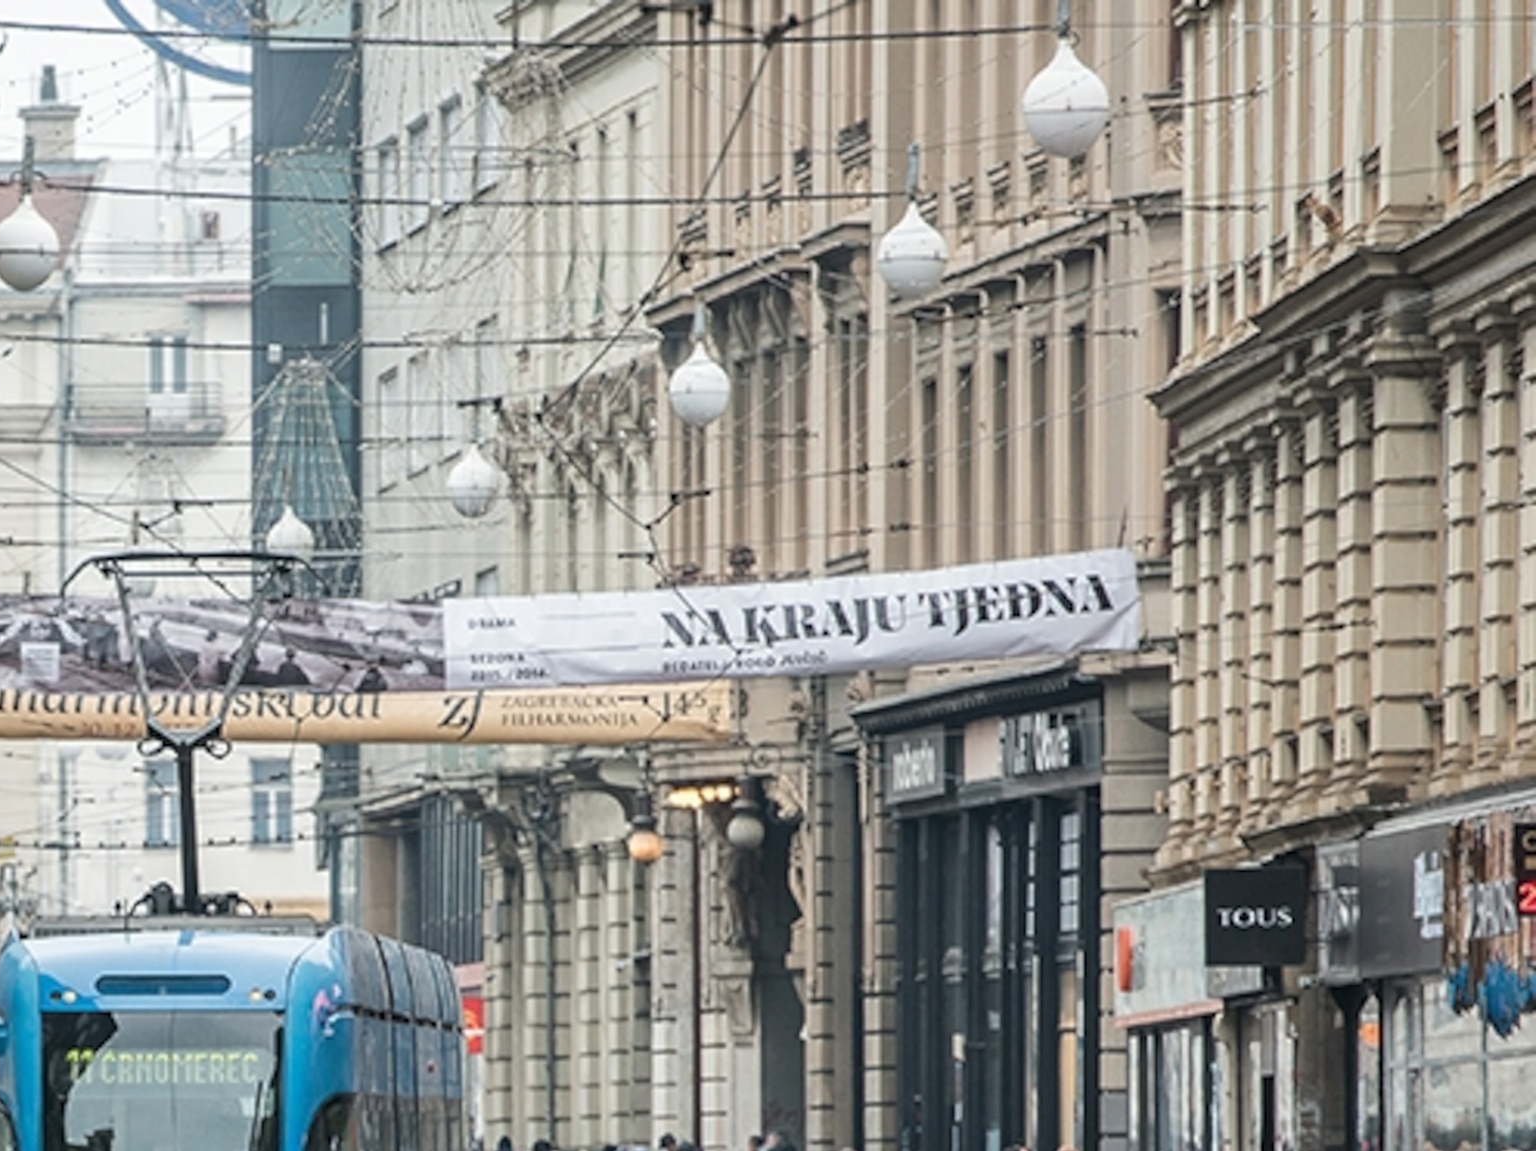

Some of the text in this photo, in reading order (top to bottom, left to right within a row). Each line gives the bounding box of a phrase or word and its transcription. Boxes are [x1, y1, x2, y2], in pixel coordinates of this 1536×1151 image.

[662, 610, 730, 648] NA
[742, 594, 906, 648] KRAJU
[1217, 906, 1293, 929] TOUS
